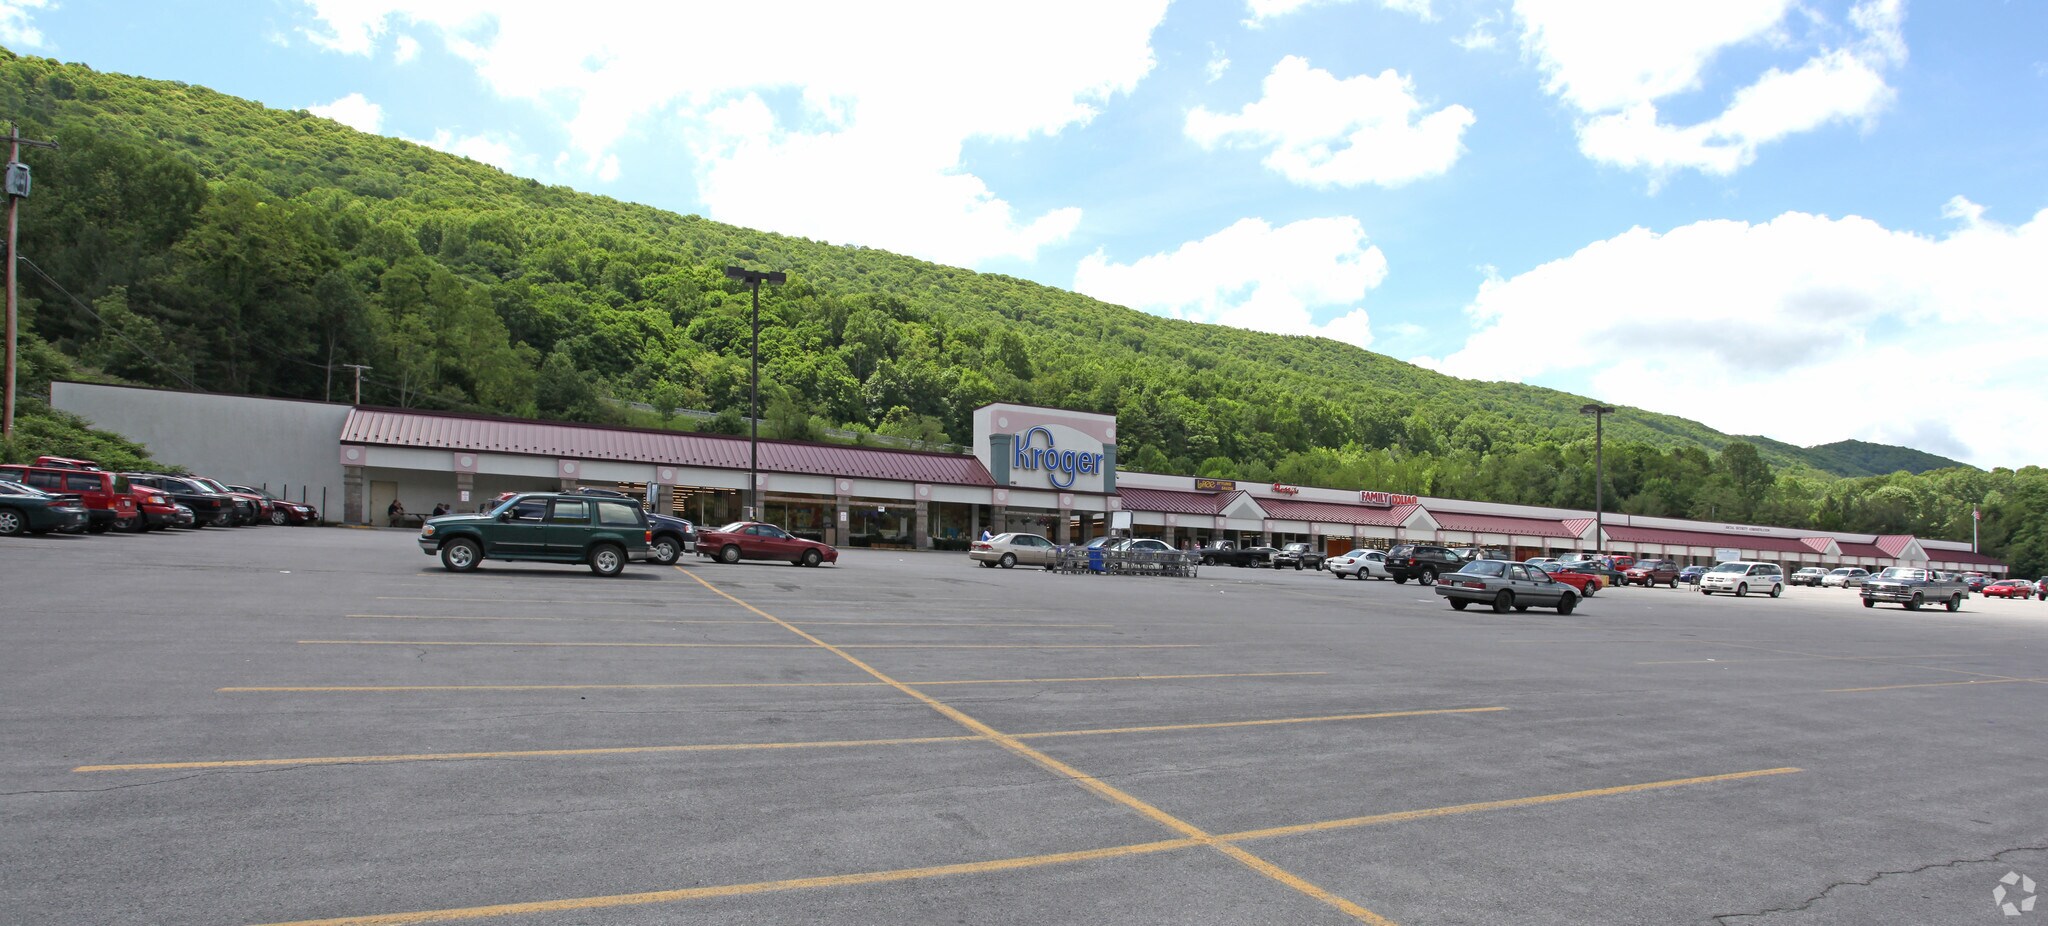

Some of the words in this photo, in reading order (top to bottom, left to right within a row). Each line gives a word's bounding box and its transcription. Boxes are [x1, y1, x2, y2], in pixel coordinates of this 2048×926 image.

[1014, 426, 1104, 488] Kroger
[1361, 491, 1389, 503] FAMILY
[1391, 494, 1417, 505] DOLLAR
